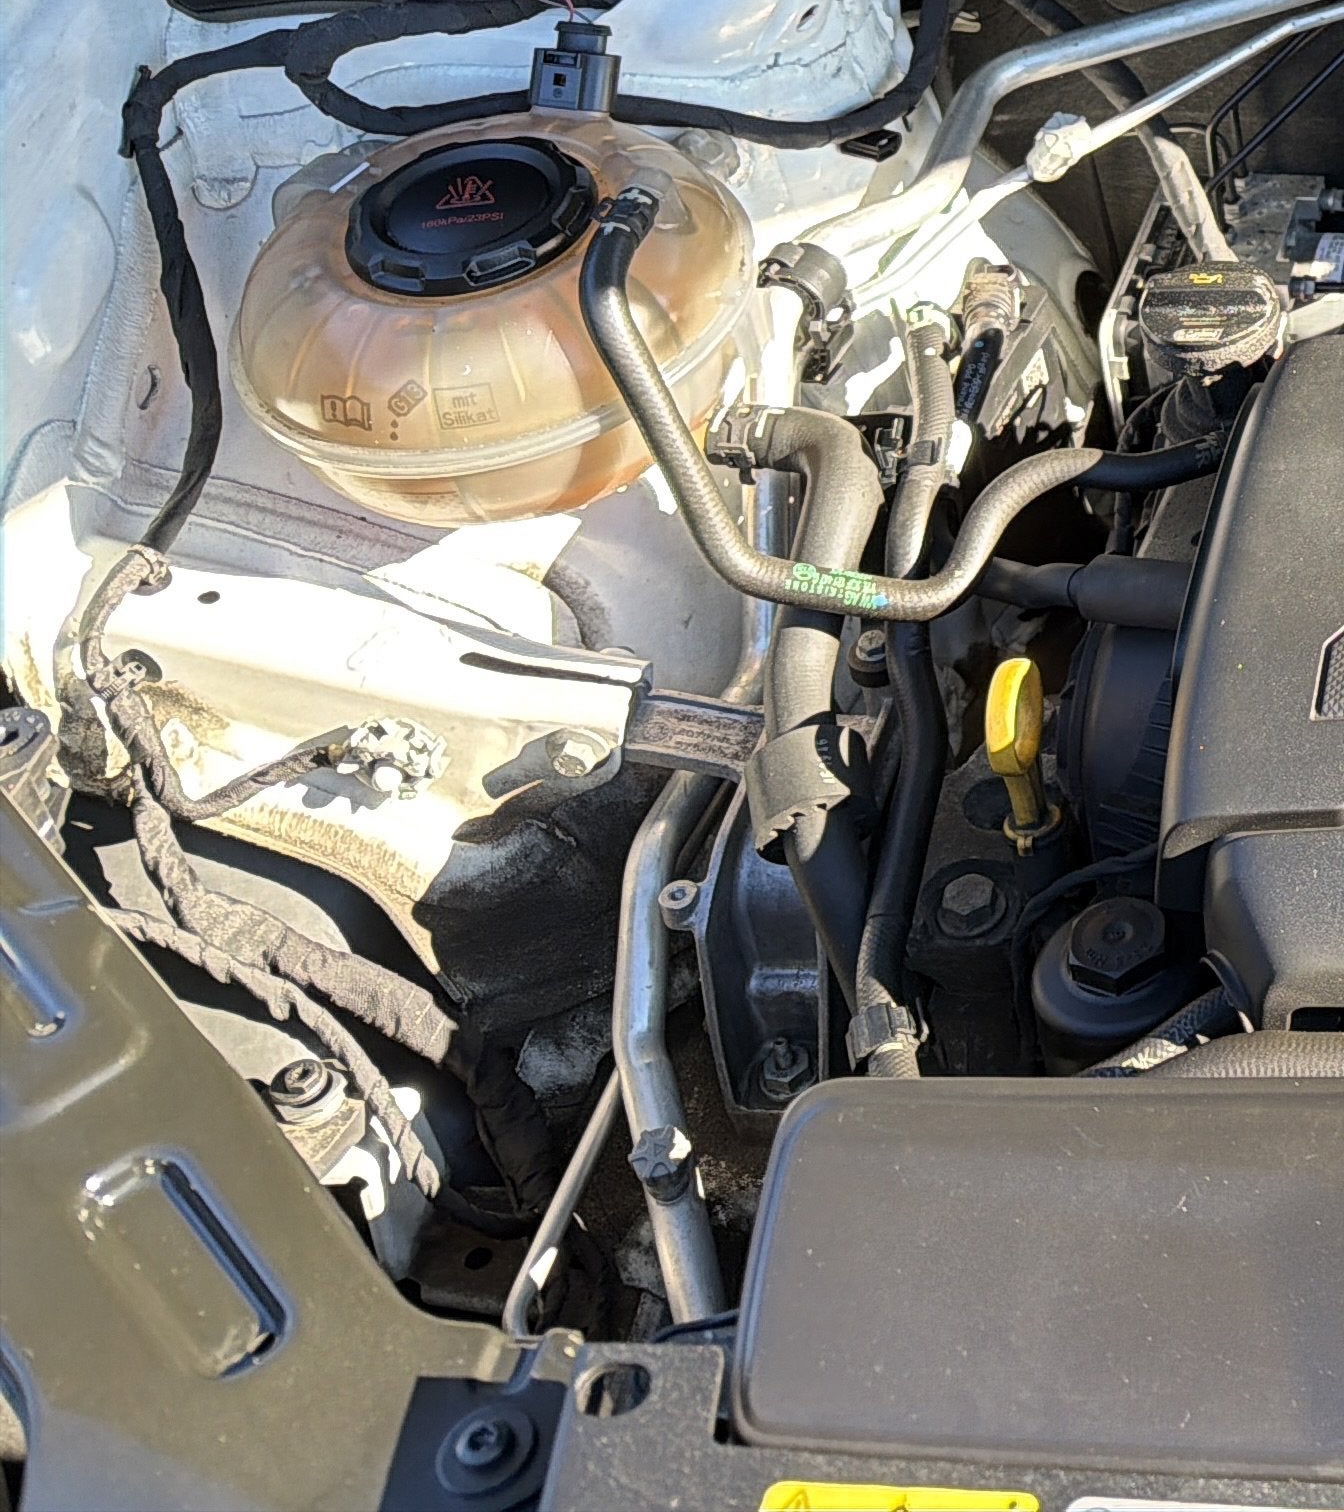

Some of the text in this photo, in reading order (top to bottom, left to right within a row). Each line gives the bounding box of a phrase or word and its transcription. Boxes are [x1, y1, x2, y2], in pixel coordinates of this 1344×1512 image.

[390, 382, 426, 413] G13
[452, 391, 478, 409] mit
[442, 408, 497, 427] Silikat
